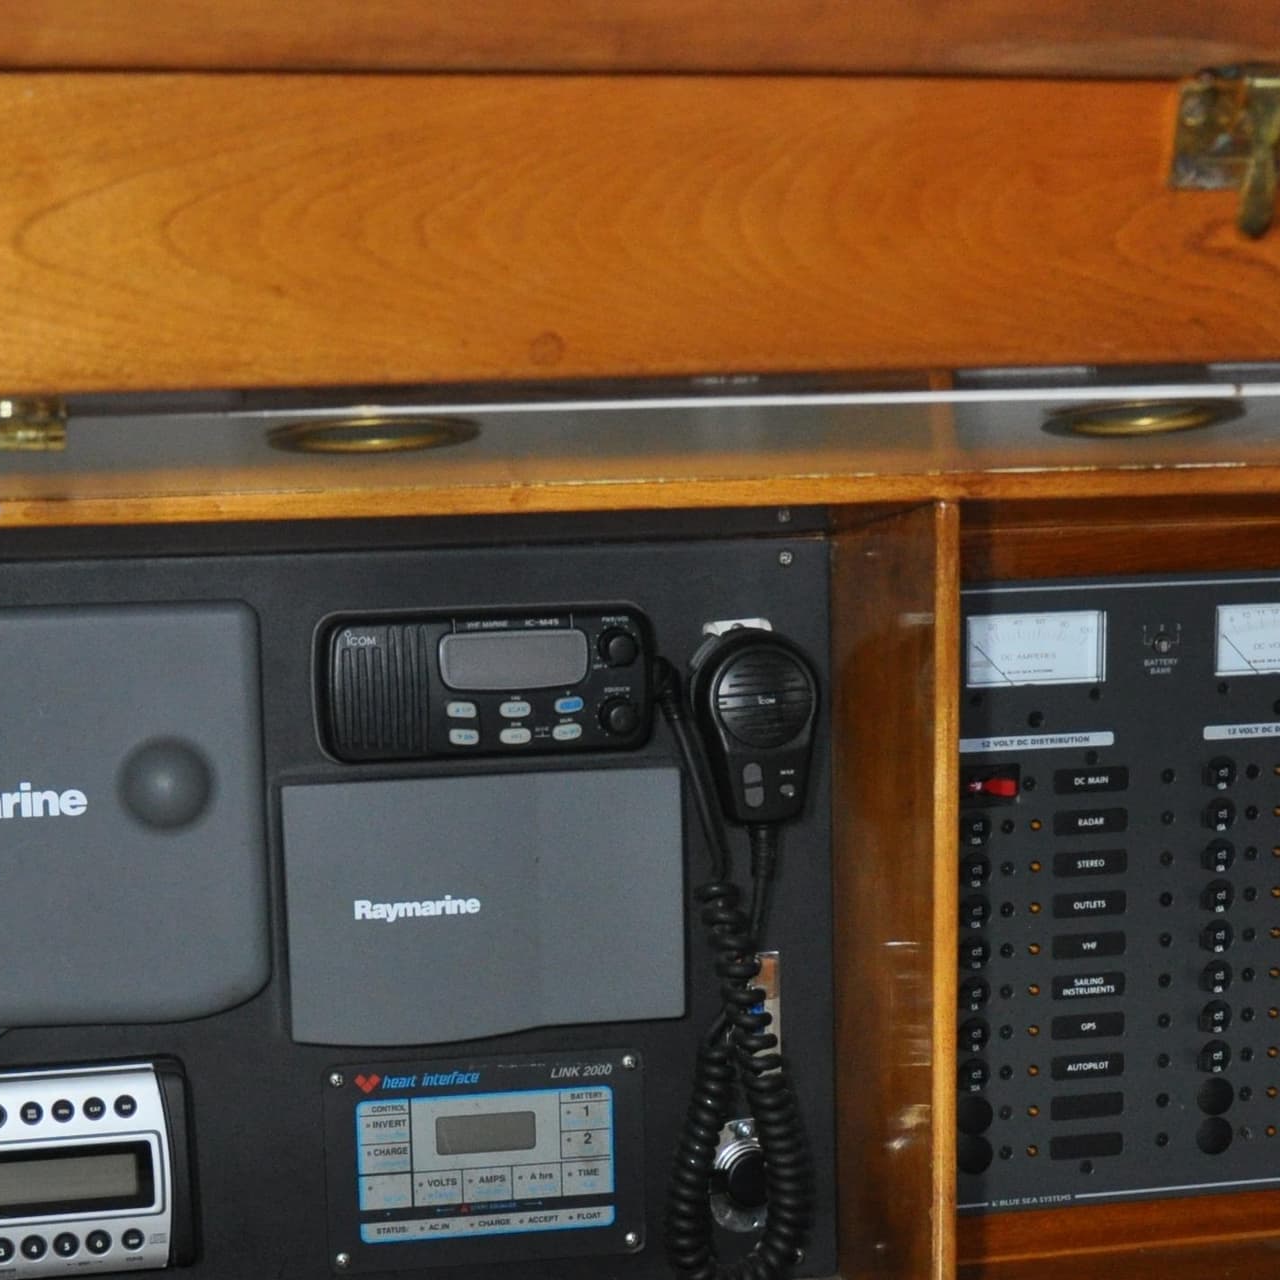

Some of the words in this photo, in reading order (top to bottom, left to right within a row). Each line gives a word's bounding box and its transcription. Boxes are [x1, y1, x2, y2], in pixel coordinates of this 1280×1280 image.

[1228, 728, 1237, 736] 12
[1262, 726, 1273, 734] DC
[993, 740, 1015, 748] VOLT
[1017, 738, 1029, 746] DC
[1031, 736, 1090, 746] DISTRIBUTION
[1074, 777, 1086, 786] DC
[1088, 776, 1109, 784] MAIN
[1078, 817, 1104, 827] RADAR
[1076, 860, 1105, 869] STEREO
[354, 894, 481, 923] Raymarine
[1073, 900, 1106, 910] OUTLETS
[1082, 942, 1098, 950] VHF
[1074, 977, 1104, 986] SAILING
[1062, 986, 1116, 996] INSTRUMENTS
[1080, 1022, 1097, 1031] GPS
[550, 1066, 580, 1078] LINK
[583, 1064, 612, 1076] 2000
[1067, 1061, 1109, 1072] AUTOPILOT
[382, 1074, 417, 1090] heart
[422, 1071, 480, 1087] interface
[570, 1092, 603, 1100] BATTERY
[372, 1104, 406, 1113] CONTROL
[584, 1106, 589, 1116] 1
[372, 1120, 407, 1128] INVERT
[584, 1132, 592, 1144] 2
[374, 1146, 408, 1157] CHARGE
[539, 1172, 554, 1180] hrs
[578, 1168, 600, 1177] TIME
[427, 1178, 458, 1188] VOLTS
[478, 1174, 506, 1184] AMPS
[1000, 1198, 1020, 1207] BLUE
[1022, 1196, 1038, 1206] SEA
[1040, 1194, 1072, 1204] SYSTEMS
[478, 1218, 511, 1228] CHARGE
[528, 1214, 560, 1224] ACCEPT
[576, 1212, 602, 1220] FLOAT
[30, 1244, 38, 1254] 4
[64, 1242, 70, 1252] 5
[96, 1240, 103, 1248] 6
